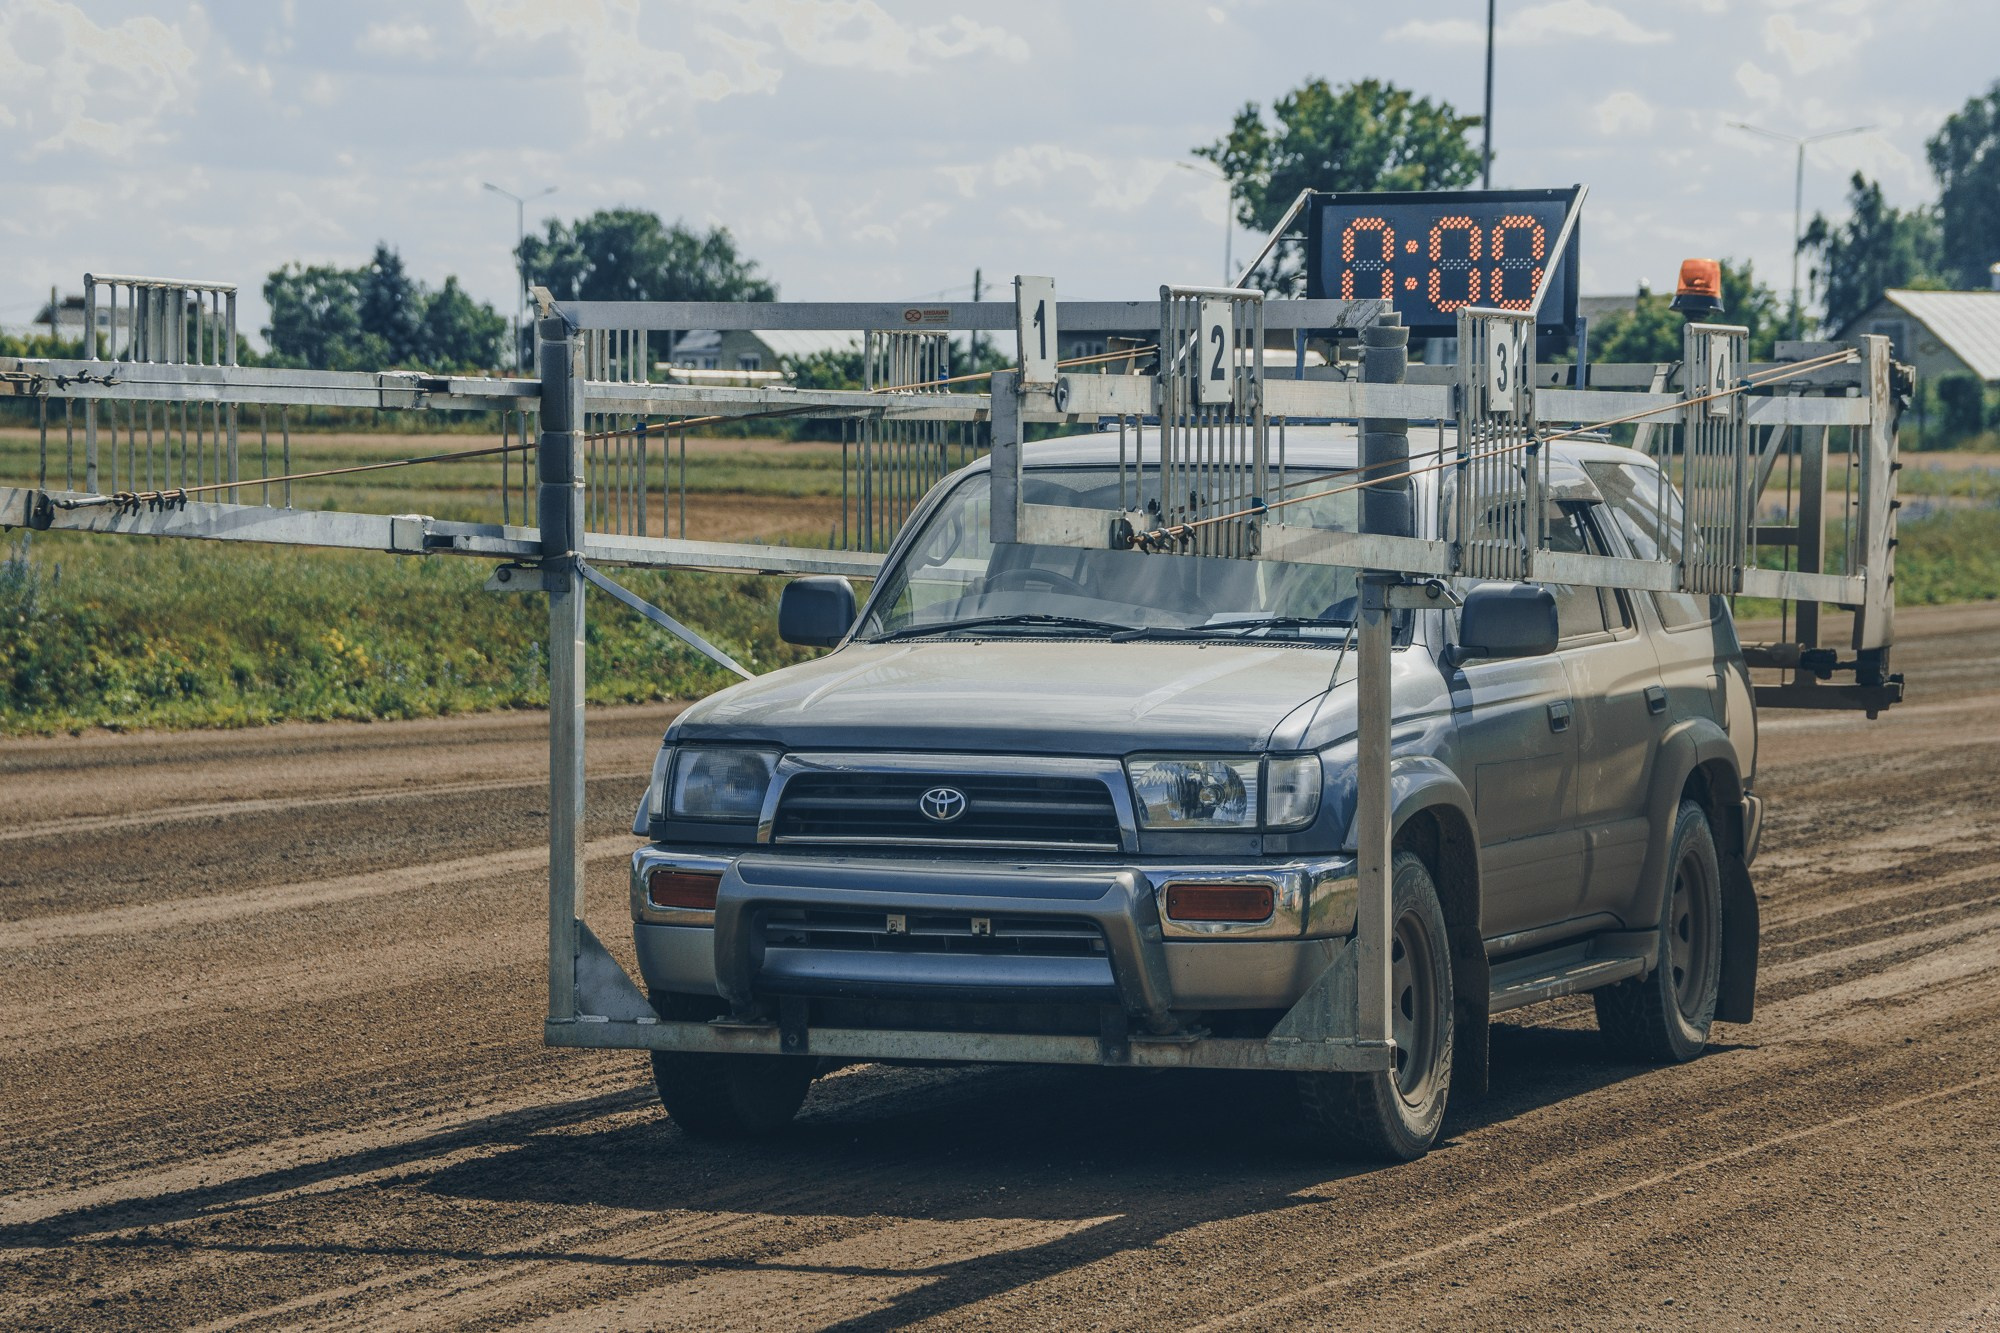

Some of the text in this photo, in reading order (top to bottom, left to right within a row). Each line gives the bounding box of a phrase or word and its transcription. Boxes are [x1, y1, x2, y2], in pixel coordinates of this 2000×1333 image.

[1033, 299, 1047, 360] 1
[1210, 324, 1226, 381] 2
[1496, 342, 1508, 392] 3
[1716, 353, 1726, 393] 4
